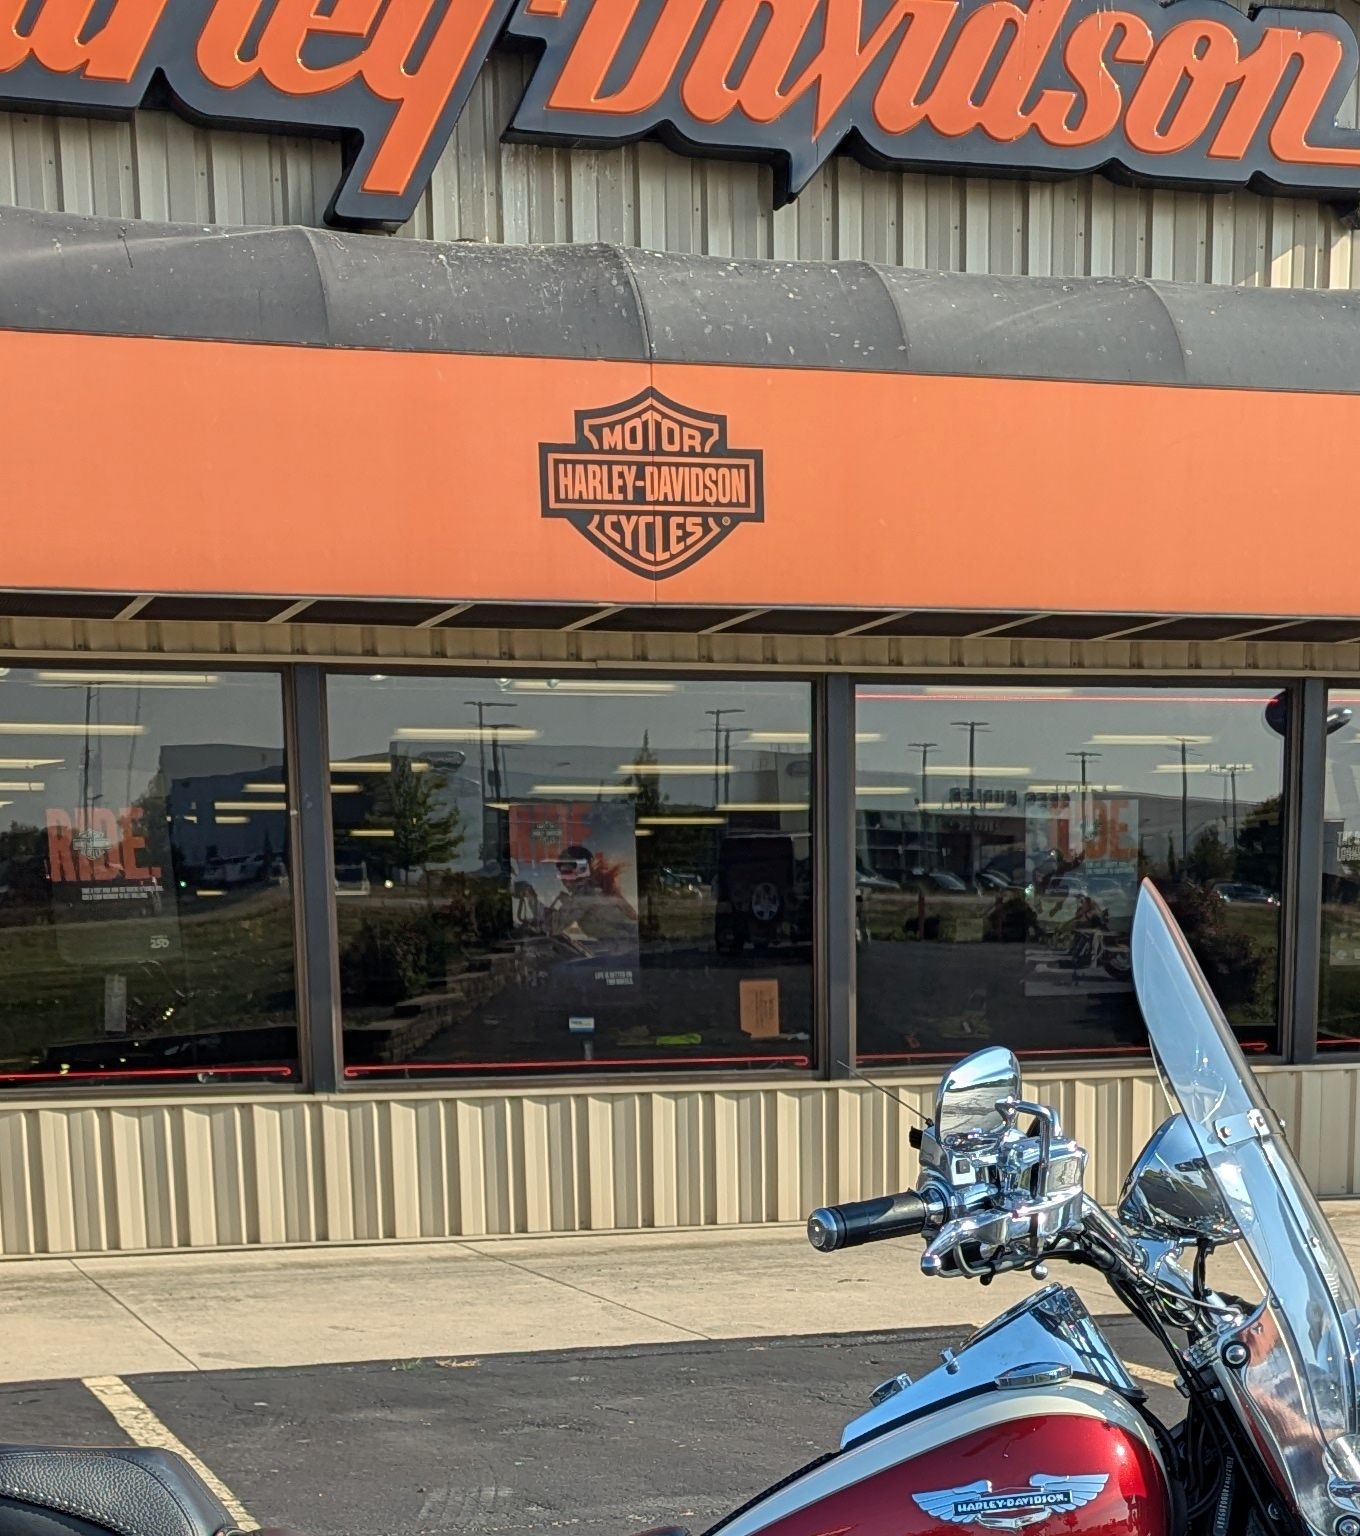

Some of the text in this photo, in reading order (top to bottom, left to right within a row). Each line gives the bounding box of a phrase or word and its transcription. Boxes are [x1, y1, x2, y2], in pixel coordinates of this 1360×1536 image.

[601, 409, 703, 453] MOTOR
[557, 463, 747, 504] HARLEY-DAVIDSON
[603, 514, 704, 562] CYCLES
